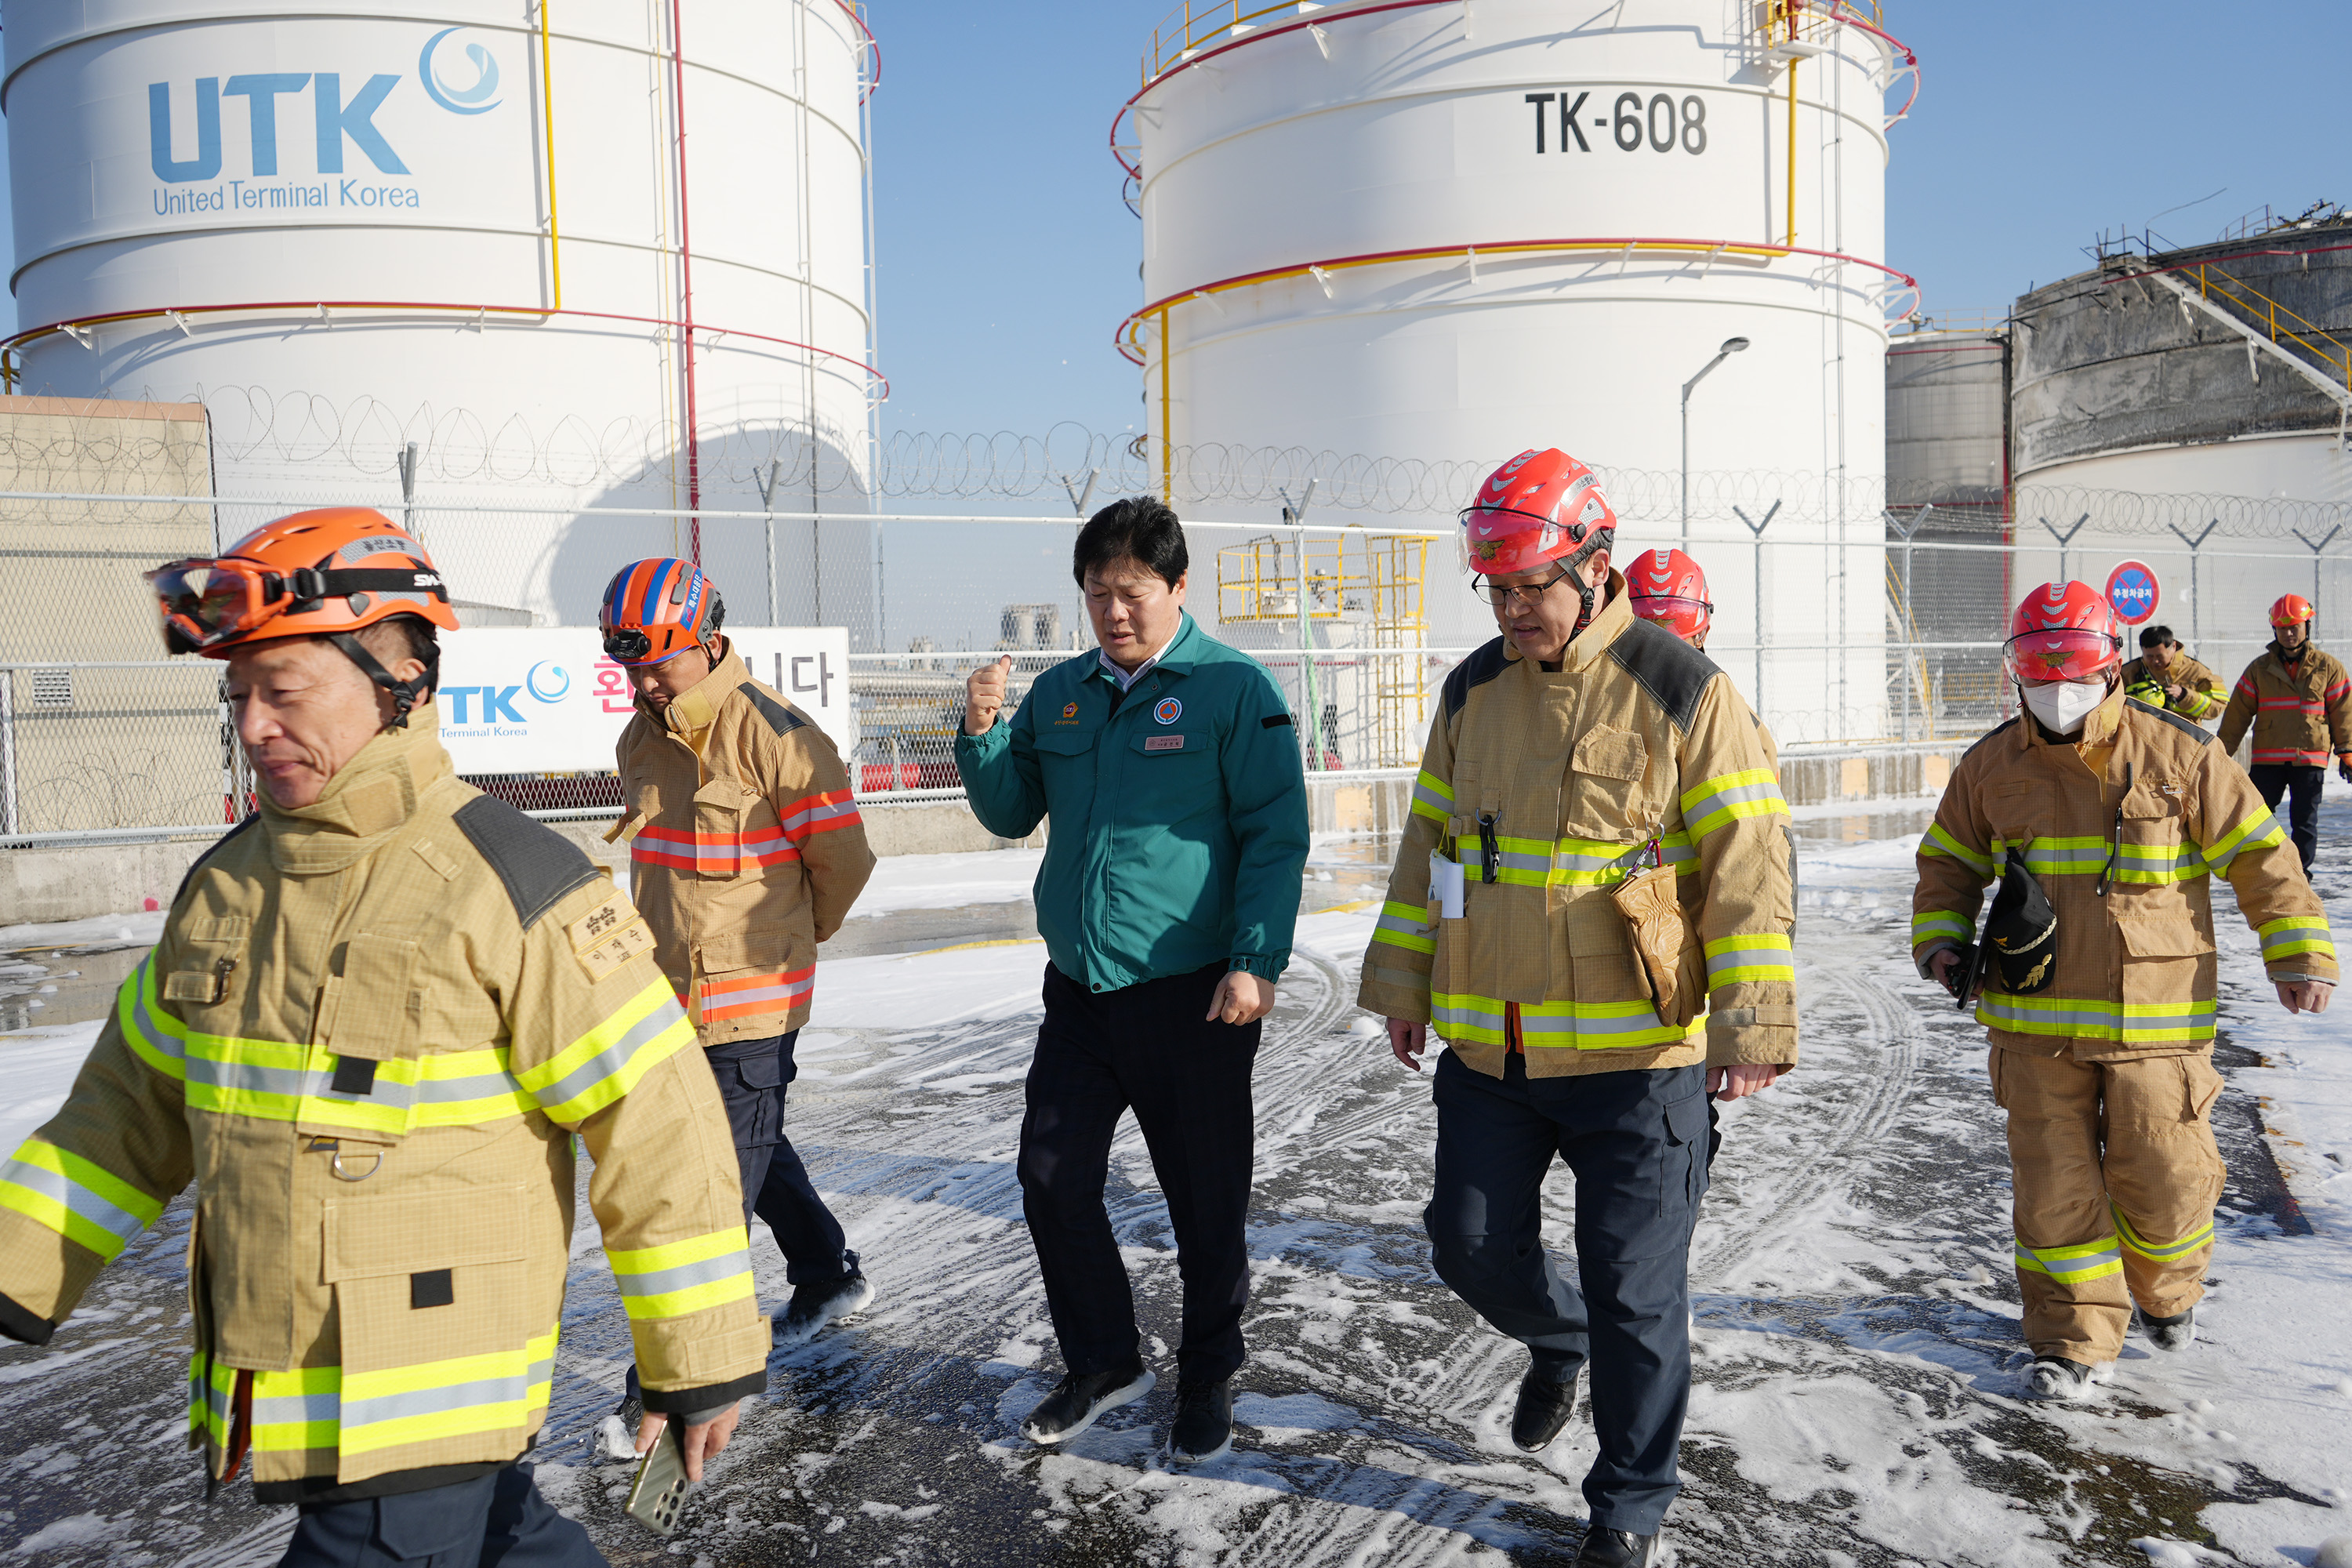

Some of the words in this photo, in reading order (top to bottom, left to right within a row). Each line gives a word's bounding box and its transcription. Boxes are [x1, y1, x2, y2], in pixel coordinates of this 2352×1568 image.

[148, 72, 413, 184] UTK
[1525, 91, 1708, 156] TK-608
[154, 185, 224, 216] United
[228, 180, 328, 209] Terminal
[339, 179, 420, 208] Korea
[688, 574, 702, 608] 특수대응단
[2113, 588, 2152, 599] 주정차금지
[437, 685, 528, 724] TK
[439, 728, 490, 738] Terminal
[494, 726, 528, 736] Korea
